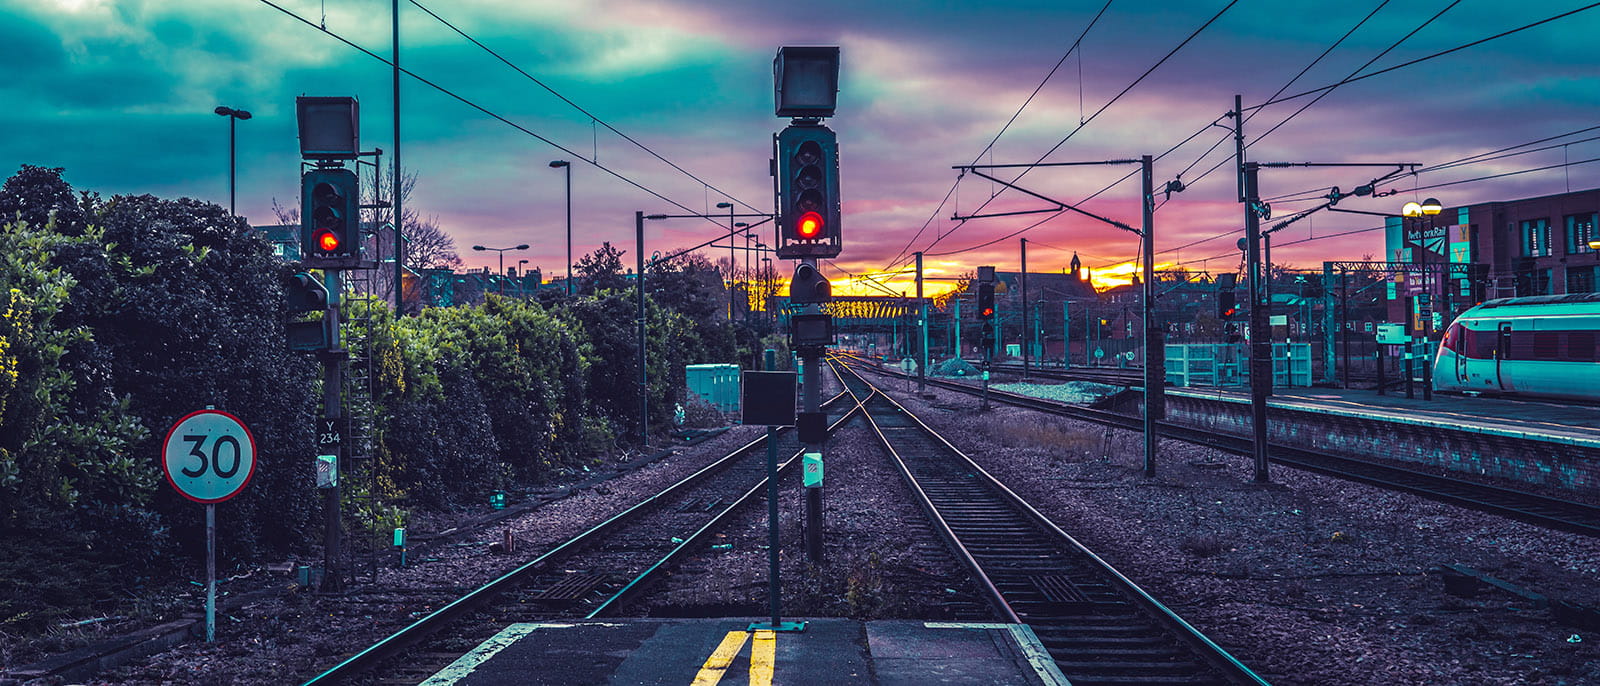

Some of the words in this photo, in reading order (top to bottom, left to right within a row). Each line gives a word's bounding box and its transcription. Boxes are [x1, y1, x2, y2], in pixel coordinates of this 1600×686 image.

[326, 421, 334, 431] Y
[320, 433, 341, 444] 234
[181, 435, 241, 478] 30
